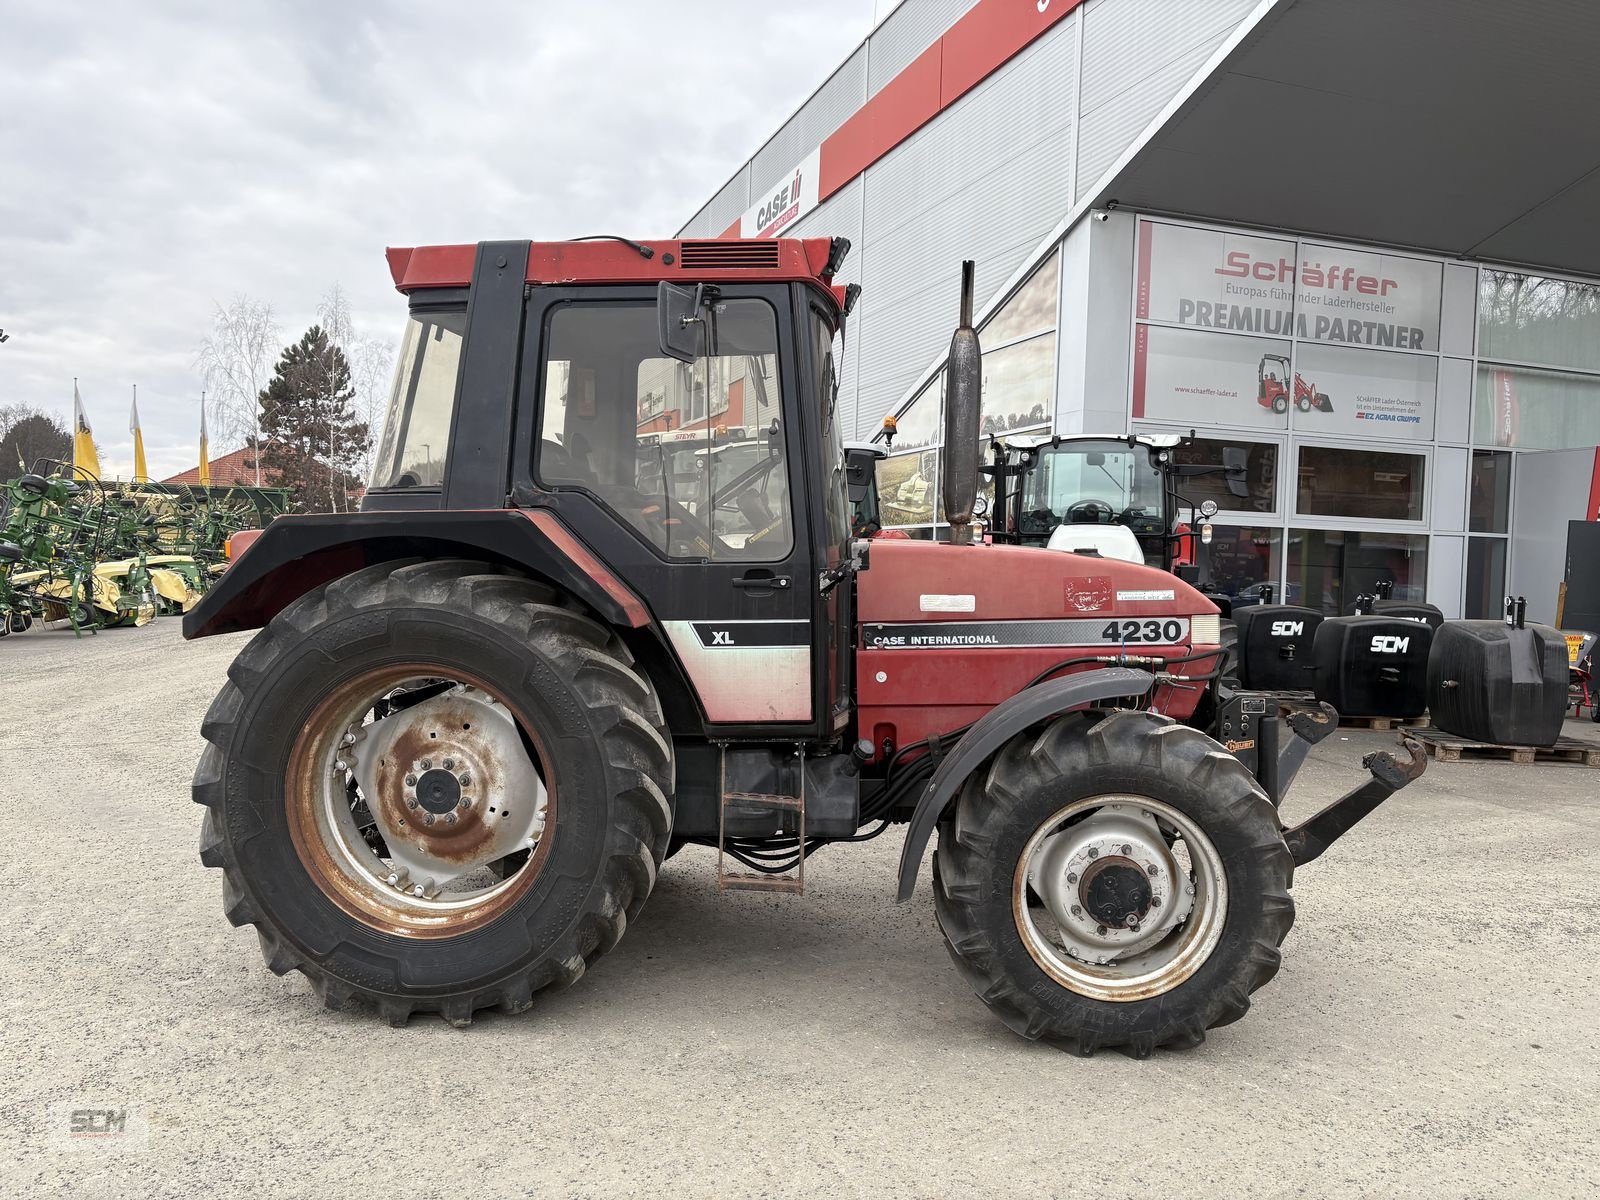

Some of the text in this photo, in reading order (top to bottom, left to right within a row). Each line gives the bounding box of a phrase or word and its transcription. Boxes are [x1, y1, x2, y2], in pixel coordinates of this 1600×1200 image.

[757, 186, 789, 231] CASE
[1215, 252, 1398, 296] Schäffer
[1226, 283, 1396, 314] Europas führnder Laderhersteller
[1179, 299, 1424, 350] PREMIUM PARTNER
[1174, 386, 1238, 398] www.schaeffer-lader.at
[1356, 395, 1381, 403] SCHÄFFER
[1396, 398, 1421, 407] Österreich
[1372, 405, 1407, 413] Unternehmen
[1375, 414, 1396, 422] AGRAR
[1396, 415, 1421, 423] GRUPPE
[674, 433, 696, 441] STEYR
[1102, 620, 1181, 642] 4230
[1271, 621, 1304, 636] SCM
[712, 631, 734, 645] XL
[873, 635, 998, 645] CASE INTERNATIONAL
[1370, 636, 1410, 653] SCM
